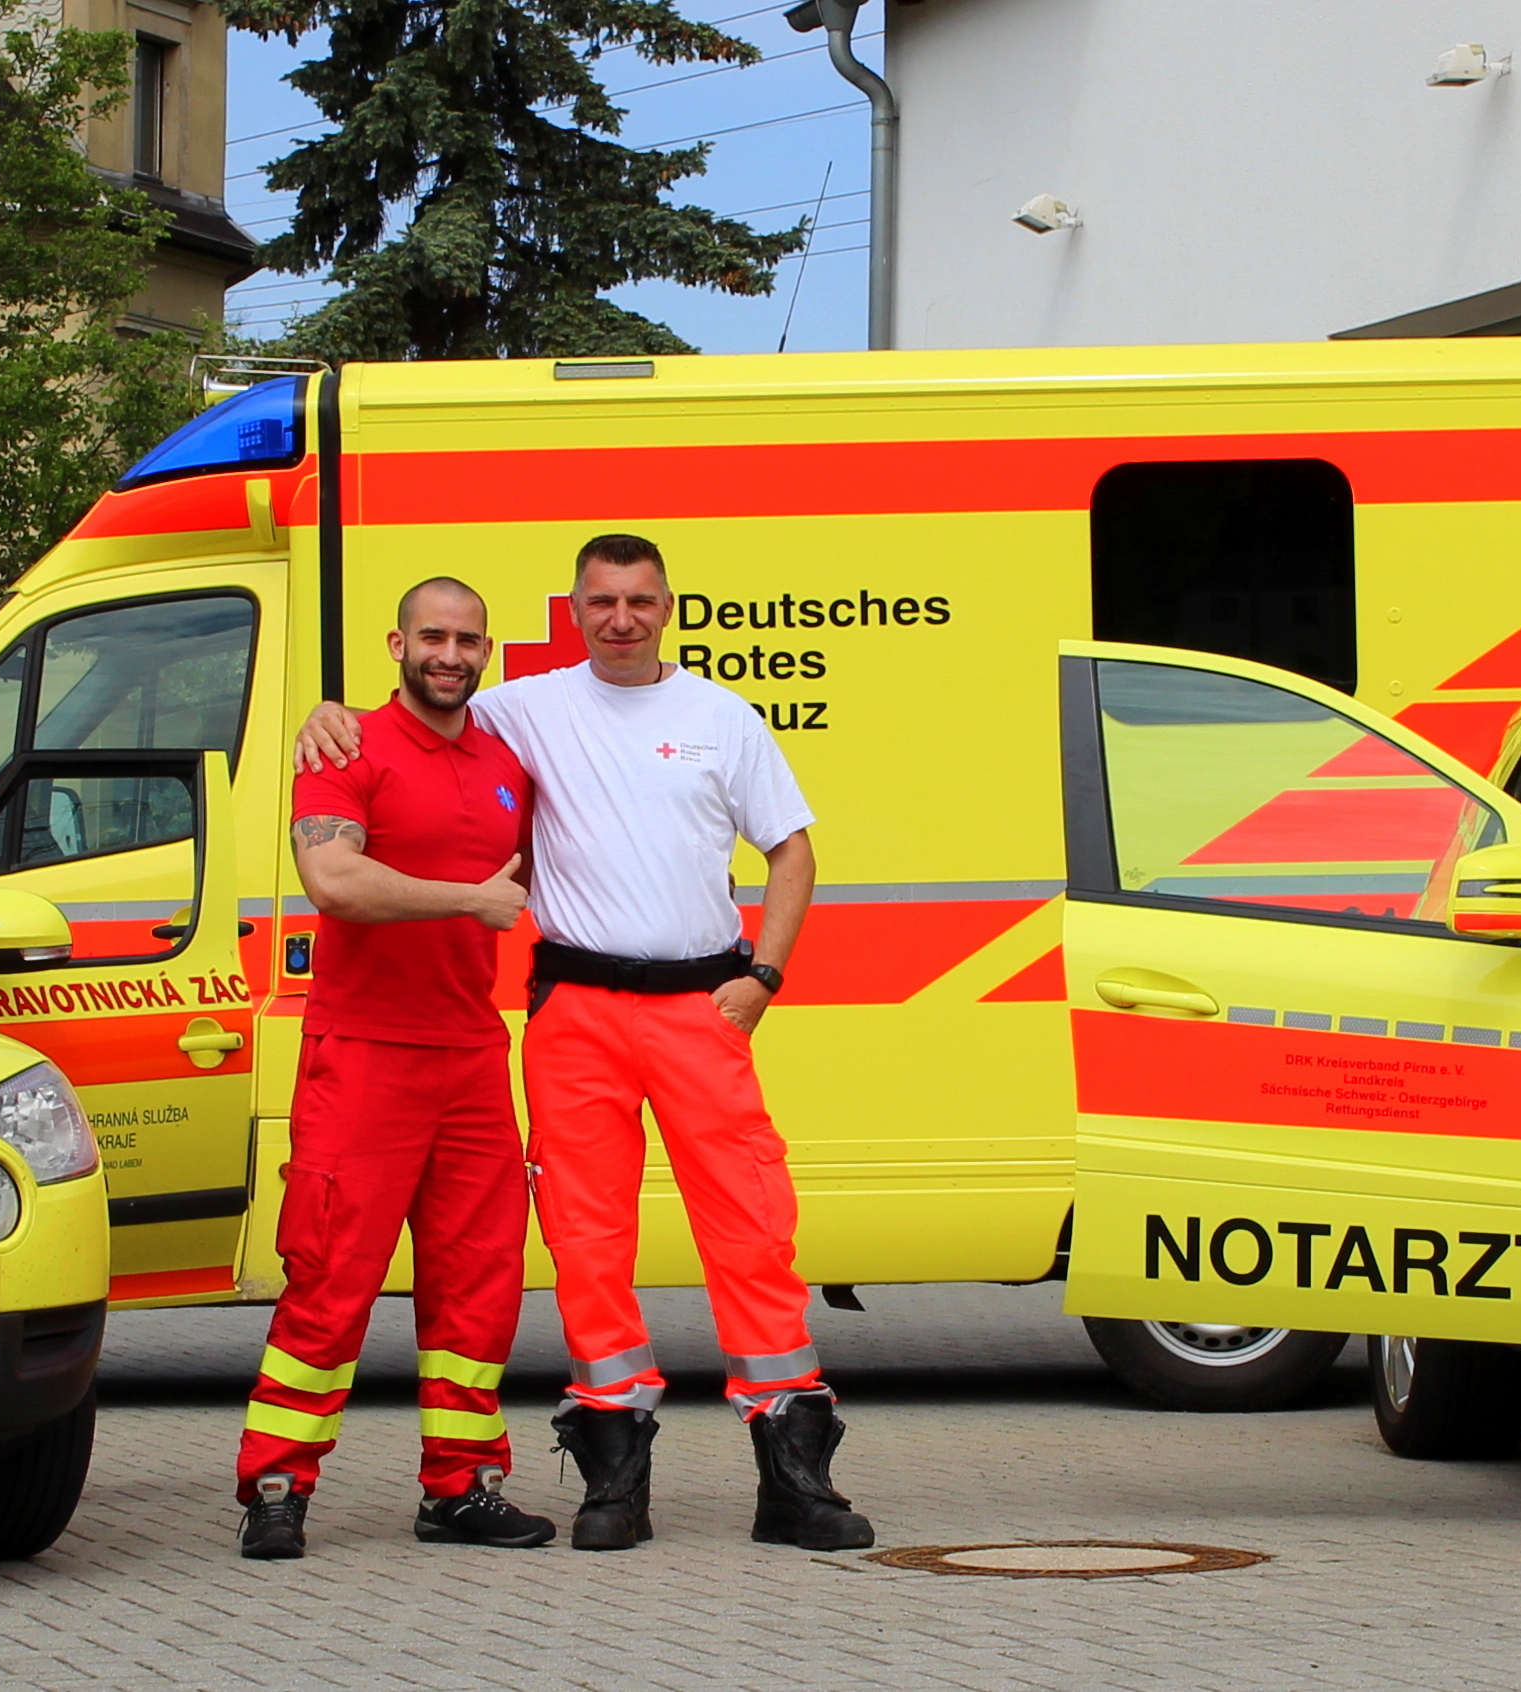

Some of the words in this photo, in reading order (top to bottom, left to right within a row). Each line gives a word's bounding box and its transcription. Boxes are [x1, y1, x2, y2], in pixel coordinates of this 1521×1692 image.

[678, 589, 951, 630] Deutsches
[679, 644, 827, 681] Rotes
[188, 968, 251, 1004] ZÁC
[1285, 1054, 1313, 1067] DRK
[1317, 1056, 1400, 1072] Kreisverband
[1403, 1062, 1436, 1074] Pirna
[1440, 1067, 1451, 1075] e.
[1454, 1065, 1466, 1076] V.
[1343, 1073, 1405, 1088] Landkreis
[1260, 1083, 1331, 1098] Sächsische
[1335, 1088, 1387, 1102] Schweiz
[1398, 1092, 1487, 1110] Osterzgebirge
[143, 1104, 189, 1125] SLUŽBA
[1325, 1103, 1420, 1119] Rettungsdienst
[97, 1133, 137, 1149] KRAJE
